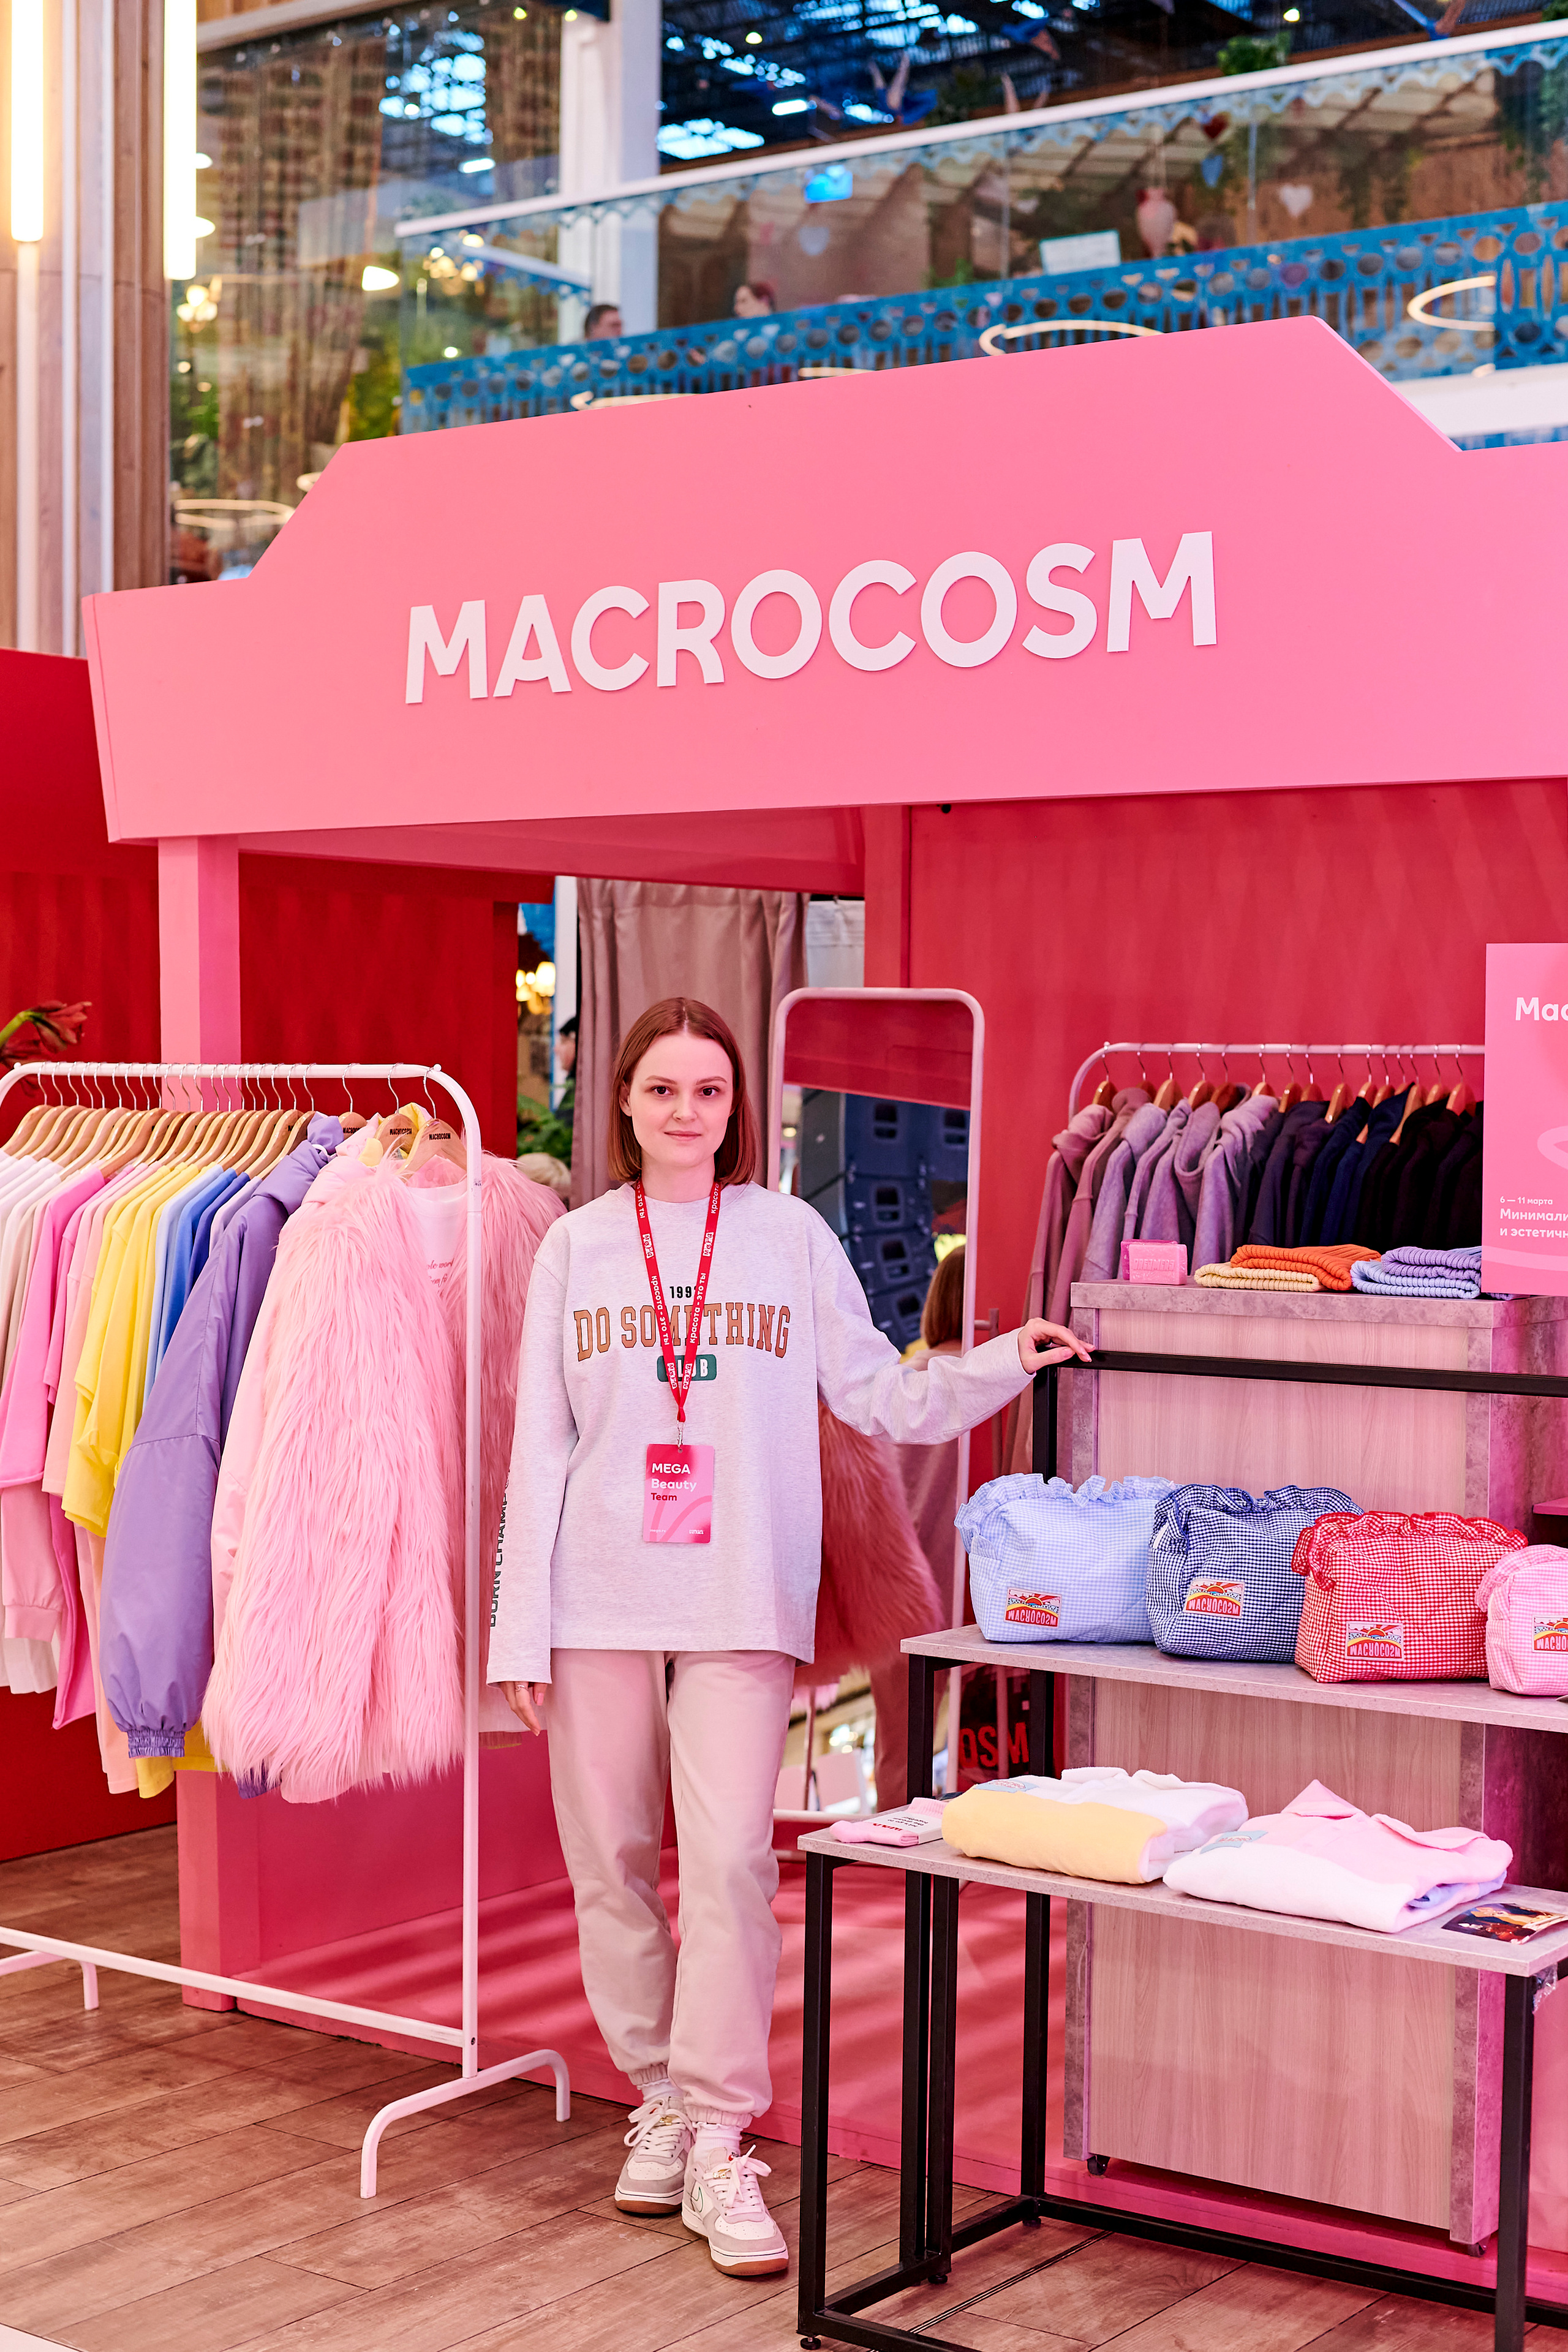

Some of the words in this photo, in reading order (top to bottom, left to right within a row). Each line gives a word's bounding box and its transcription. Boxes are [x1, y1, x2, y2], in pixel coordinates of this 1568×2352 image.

[405, 531, 1216, 704] MACROCOSM
[1500, 1208, 1568, 1221] Минимали
[1510, 1228, 1568, 1238] эстетичн
[669, 1286, 697, 1298] 199
[651, 1275, 663, 1310] красота
[663, 1333, 669, 1345] ты
[690, 1307, 700, 1343] красота
[700, 1273, 706, 1283] ты
[573, 1306, 611, 1362] DO
[652, 1463, 690, 1474] MEGA
[651, 1478, 697, 1492] Beauty
[650, 1493, 677, 1501] Team
